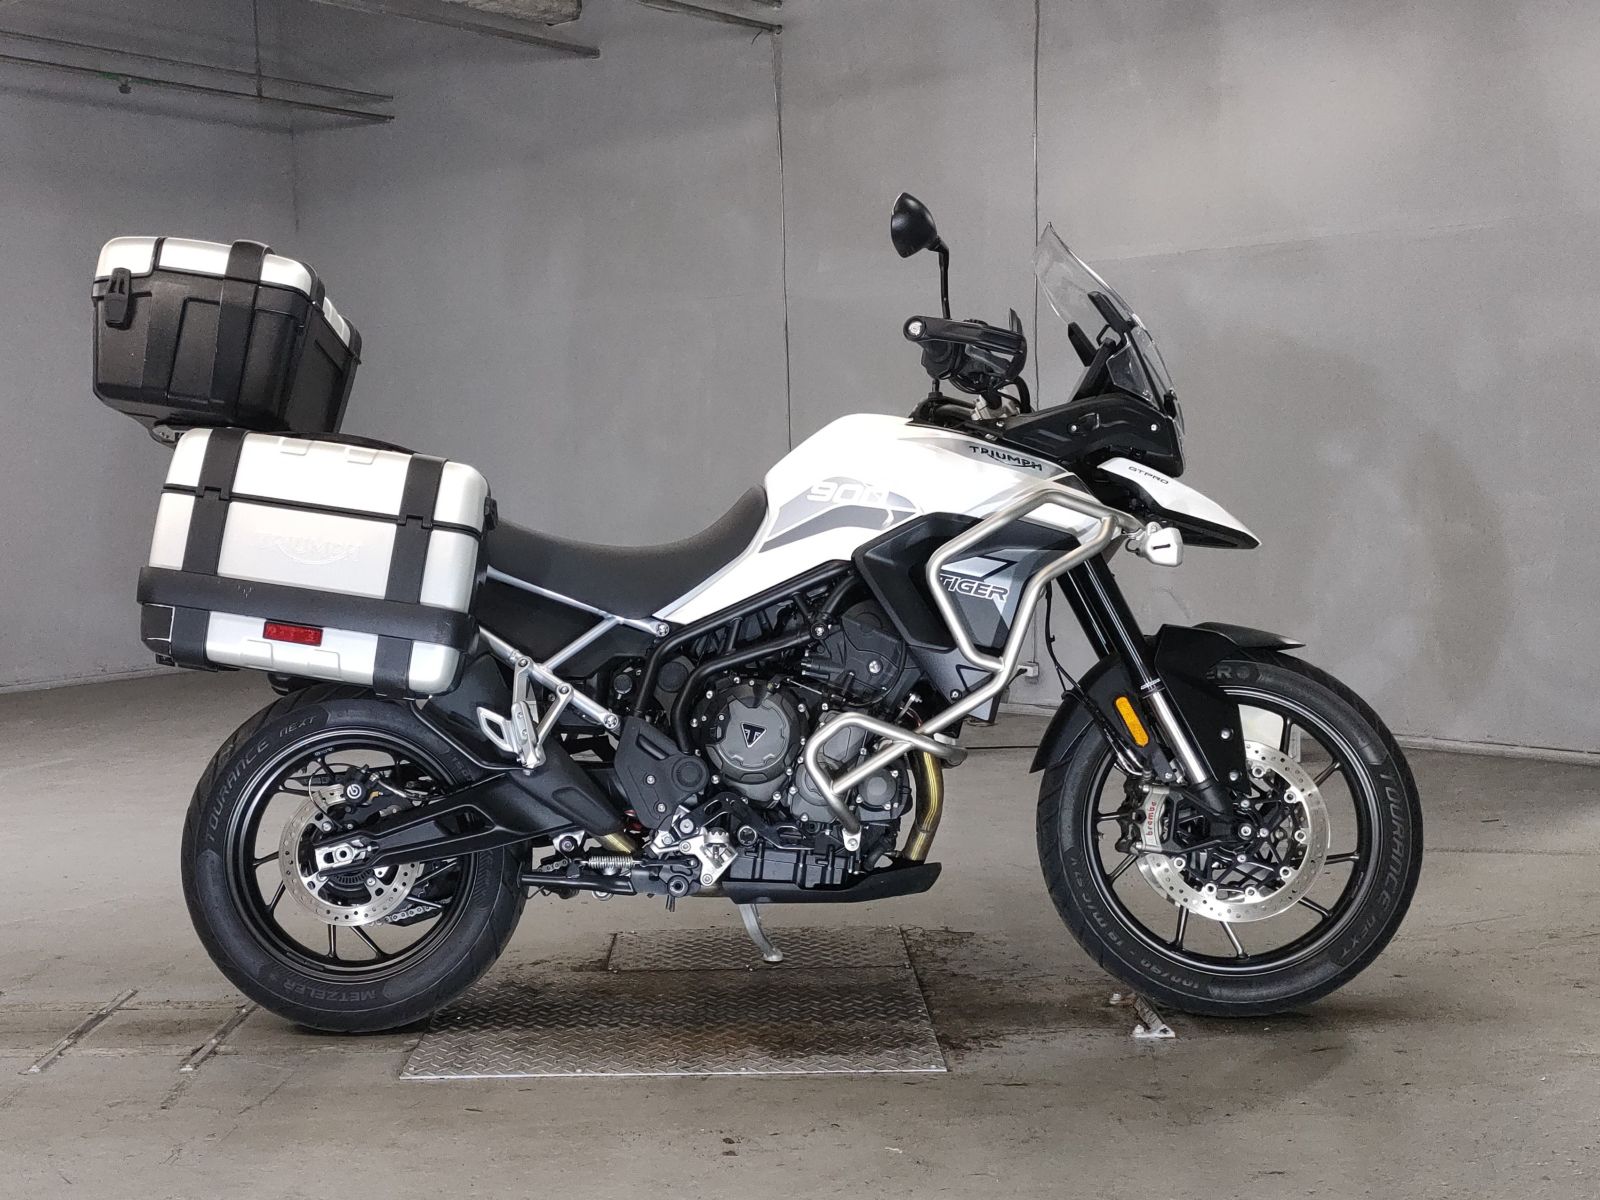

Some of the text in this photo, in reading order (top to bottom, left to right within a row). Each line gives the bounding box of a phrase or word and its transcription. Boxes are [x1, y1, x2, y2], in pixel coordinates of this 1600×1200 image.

[968, 445, 1043, 471] TRIUMPH
[1146, 800, 1157, 836] brembo
[283, 979, 377, 1002] METZELER
